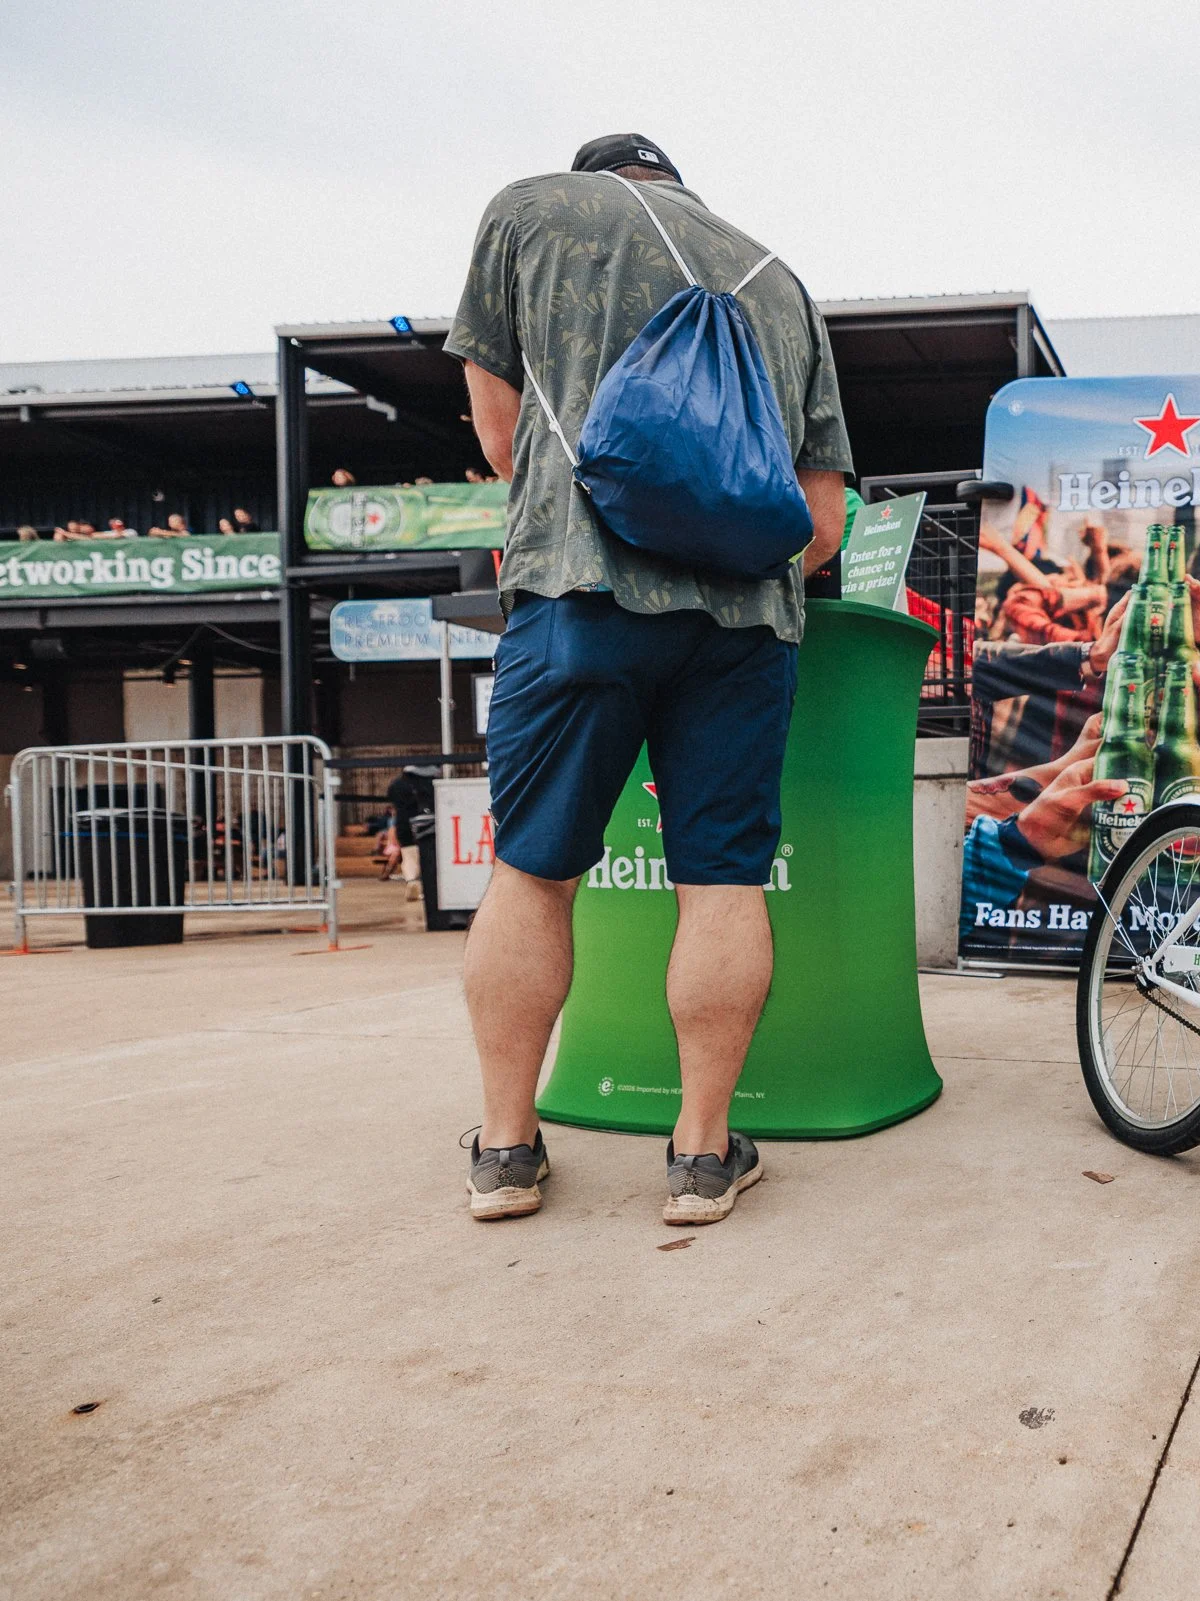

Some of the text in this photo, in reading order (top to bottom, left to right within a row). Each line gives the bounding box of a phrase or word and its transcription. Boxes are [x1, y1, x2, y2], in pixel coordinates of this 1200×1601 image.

[181, 547, 282, 582] Since
[848, 545, 903, 565] Enter for a
[848, 560, 896, 579] chance to
[858, 582, 865, 591] a
[865, 573, 898, 593] prize!
[344, 611, 430, 628] RESTROO
[344, 632, 430, 649] PREMIUM
[637, 818, 654, 829] EST.
[974, 901, 1042, 929] Fans
